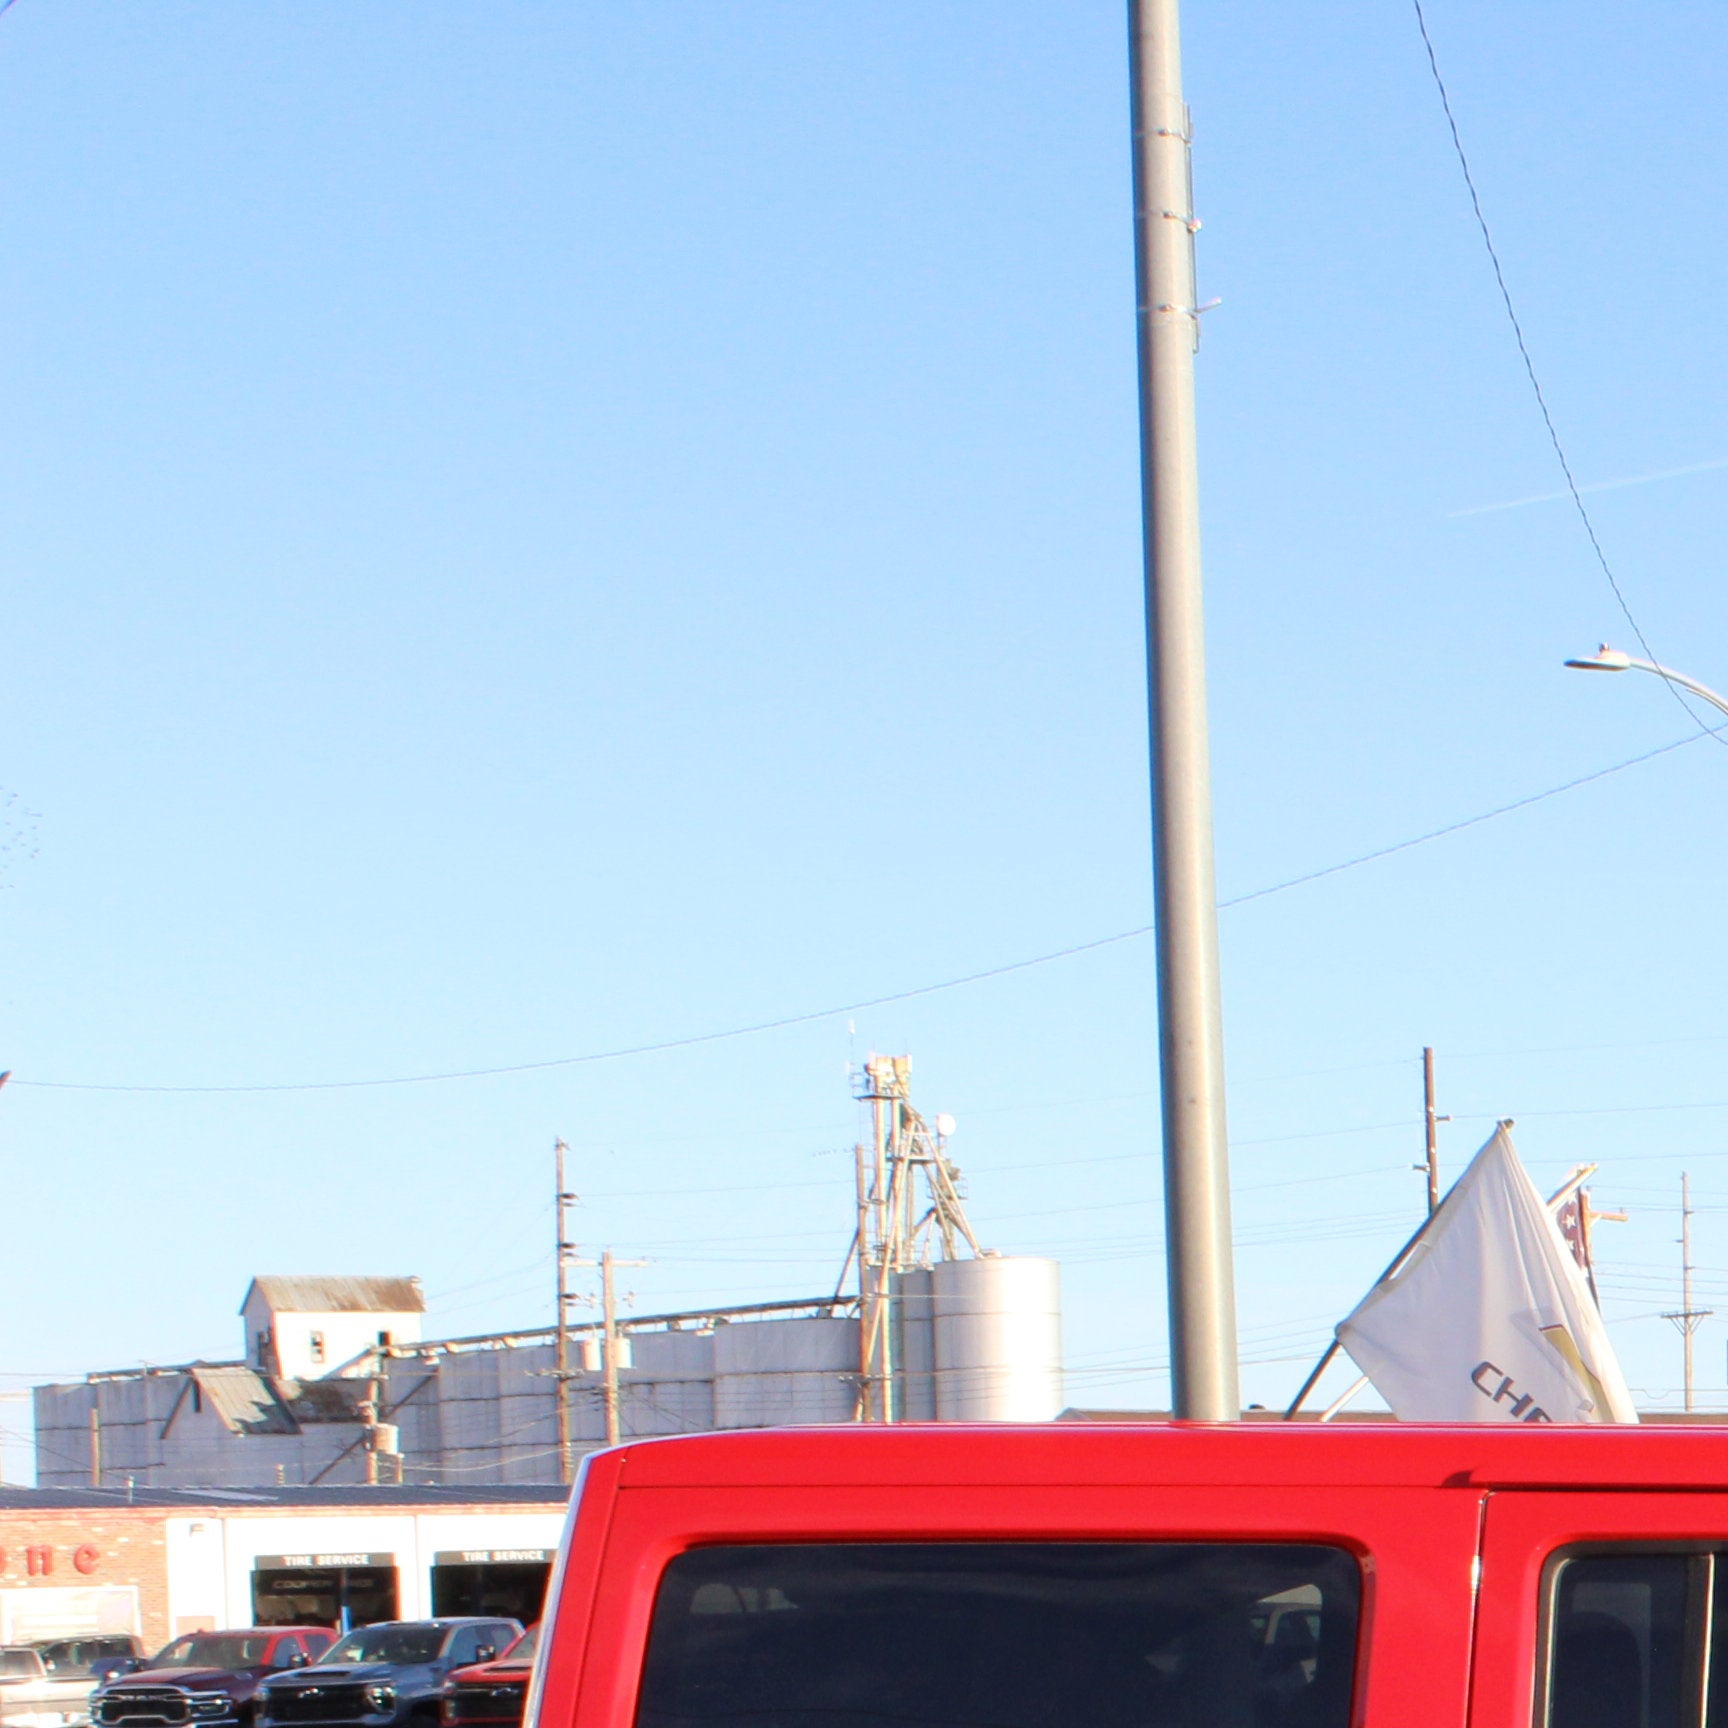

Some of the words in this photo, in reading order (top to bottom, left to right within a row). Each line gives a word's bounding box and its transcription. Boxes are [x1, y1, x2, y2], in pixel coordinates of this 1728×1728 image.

[0, 1544, 101, 1576] ne
[283, 1556, 312, 1566] TIRE
[314, 1554, 369, 1566] SERVICE
[462, 1551, 490, 1562] TIRE
[492, 1550, 545, 1561] SERVICE
